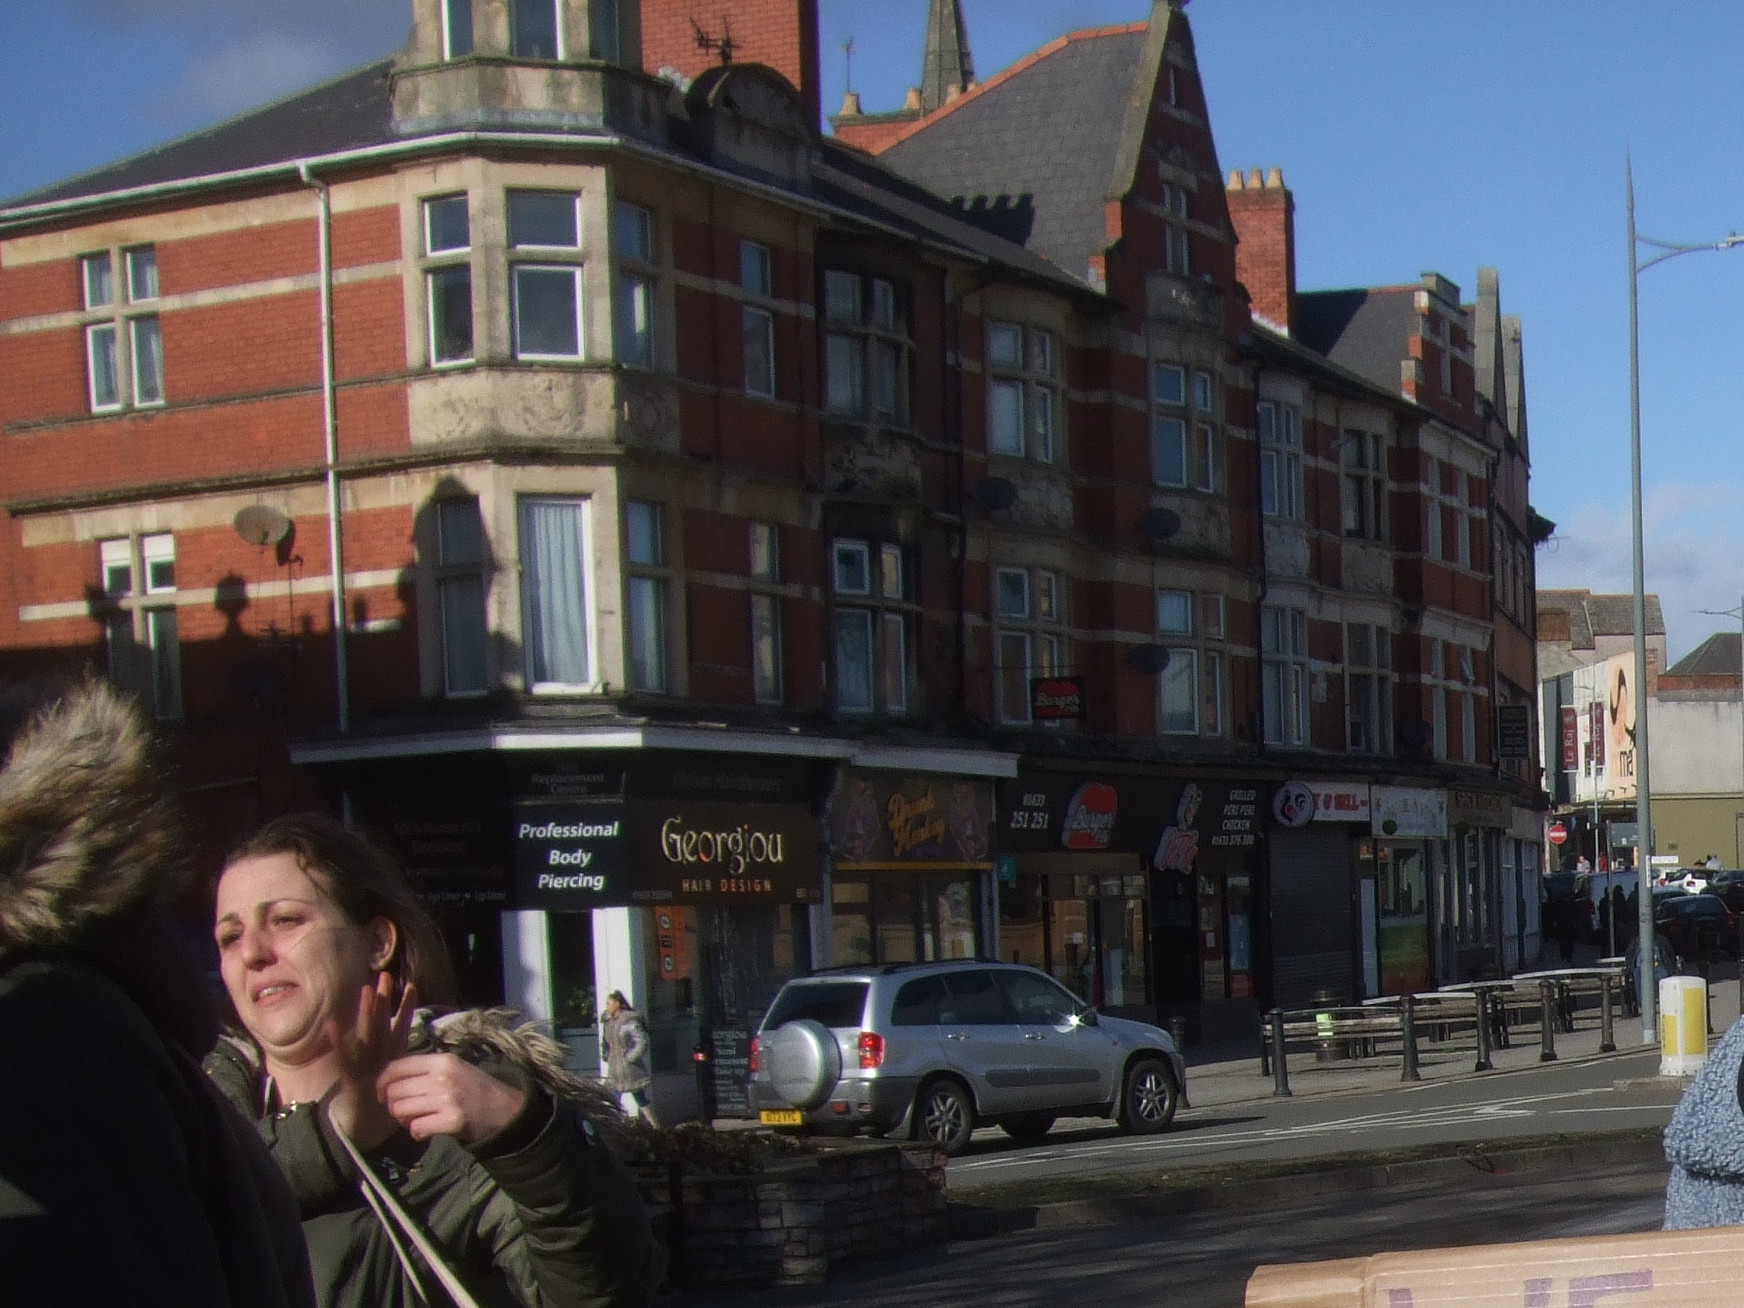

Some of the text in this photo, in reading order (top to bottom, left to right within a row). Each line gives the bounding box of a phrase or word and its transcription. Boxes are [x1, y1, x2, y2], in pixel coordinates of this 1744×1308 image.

[518, 821, 620, 840] Professional
[1031, 812, 1050, 830] 251
[660, 814, 785, 875] Georgiou
[548, 848, 593, 868] Body
[537, 873, 605, 892] Piercing
[681, 879, 772, 892] HAIR DESIGN
